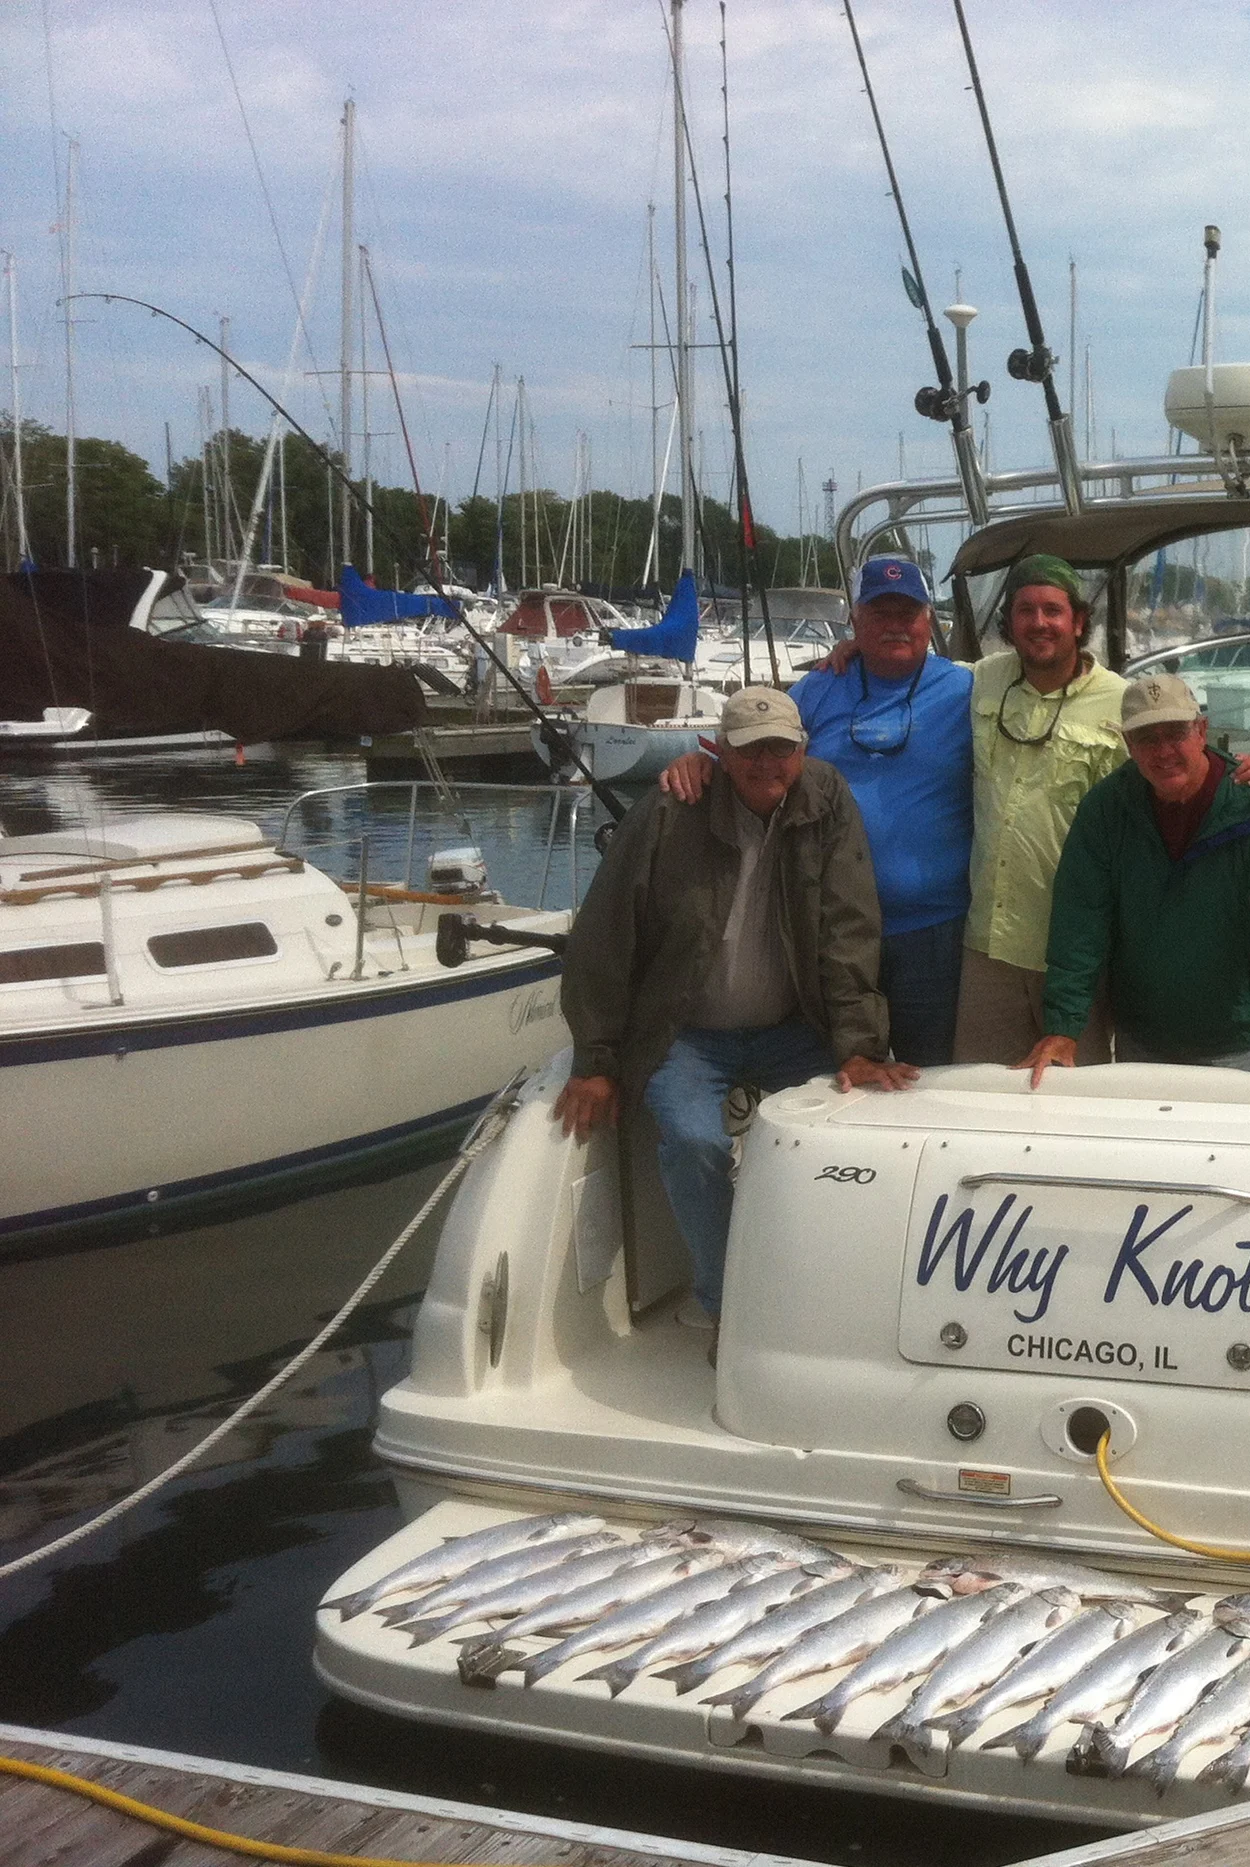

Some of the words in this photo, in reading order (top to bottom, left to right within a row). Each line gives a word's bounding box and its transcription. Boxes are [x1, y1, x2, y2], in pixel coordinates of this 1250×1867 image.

[814, 1165, 877, 1185] 290
[916, 1192, 1070, 1324] Why
[1006, 1333, 1145, 1370] CHICAGO,
[1153, 1346, 1178, 1370] IL
